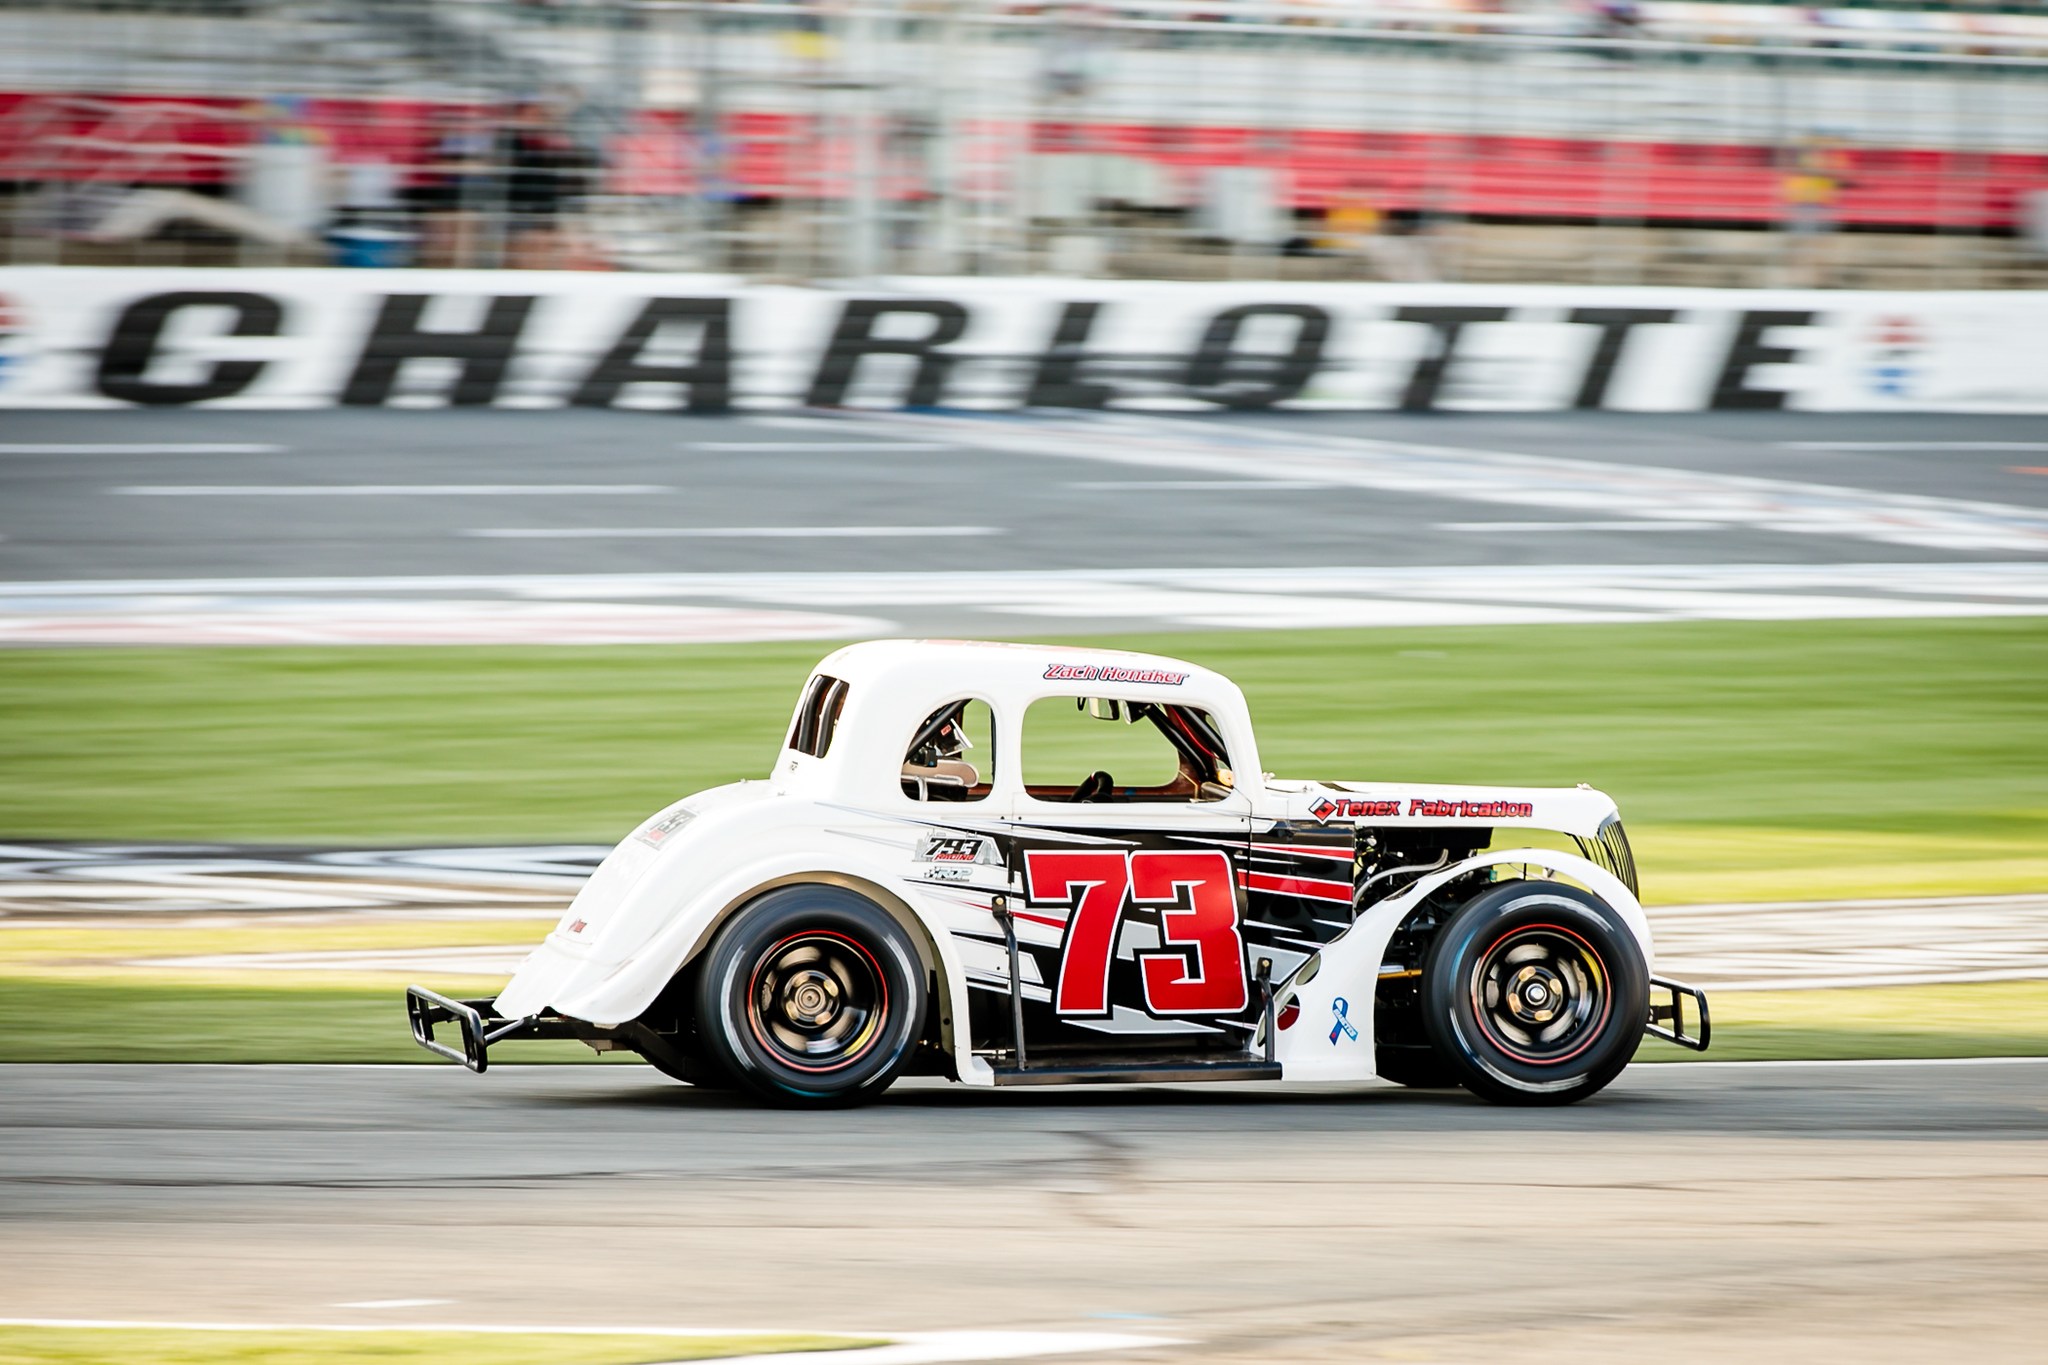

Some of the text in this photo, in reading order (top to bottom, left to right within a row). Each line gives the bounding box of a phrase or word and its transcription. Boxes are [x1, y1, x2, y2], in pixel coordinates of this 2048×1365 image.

[95, 290, 1816, 413] CHARLOTTE
[1043, 664, 1189, 685] Zach Honaker
[1335, 798, 1533, 817] Tenex Fabrication
[925, 837, 983, 855] 793
[1024, 850, 1249, 1014] 73
